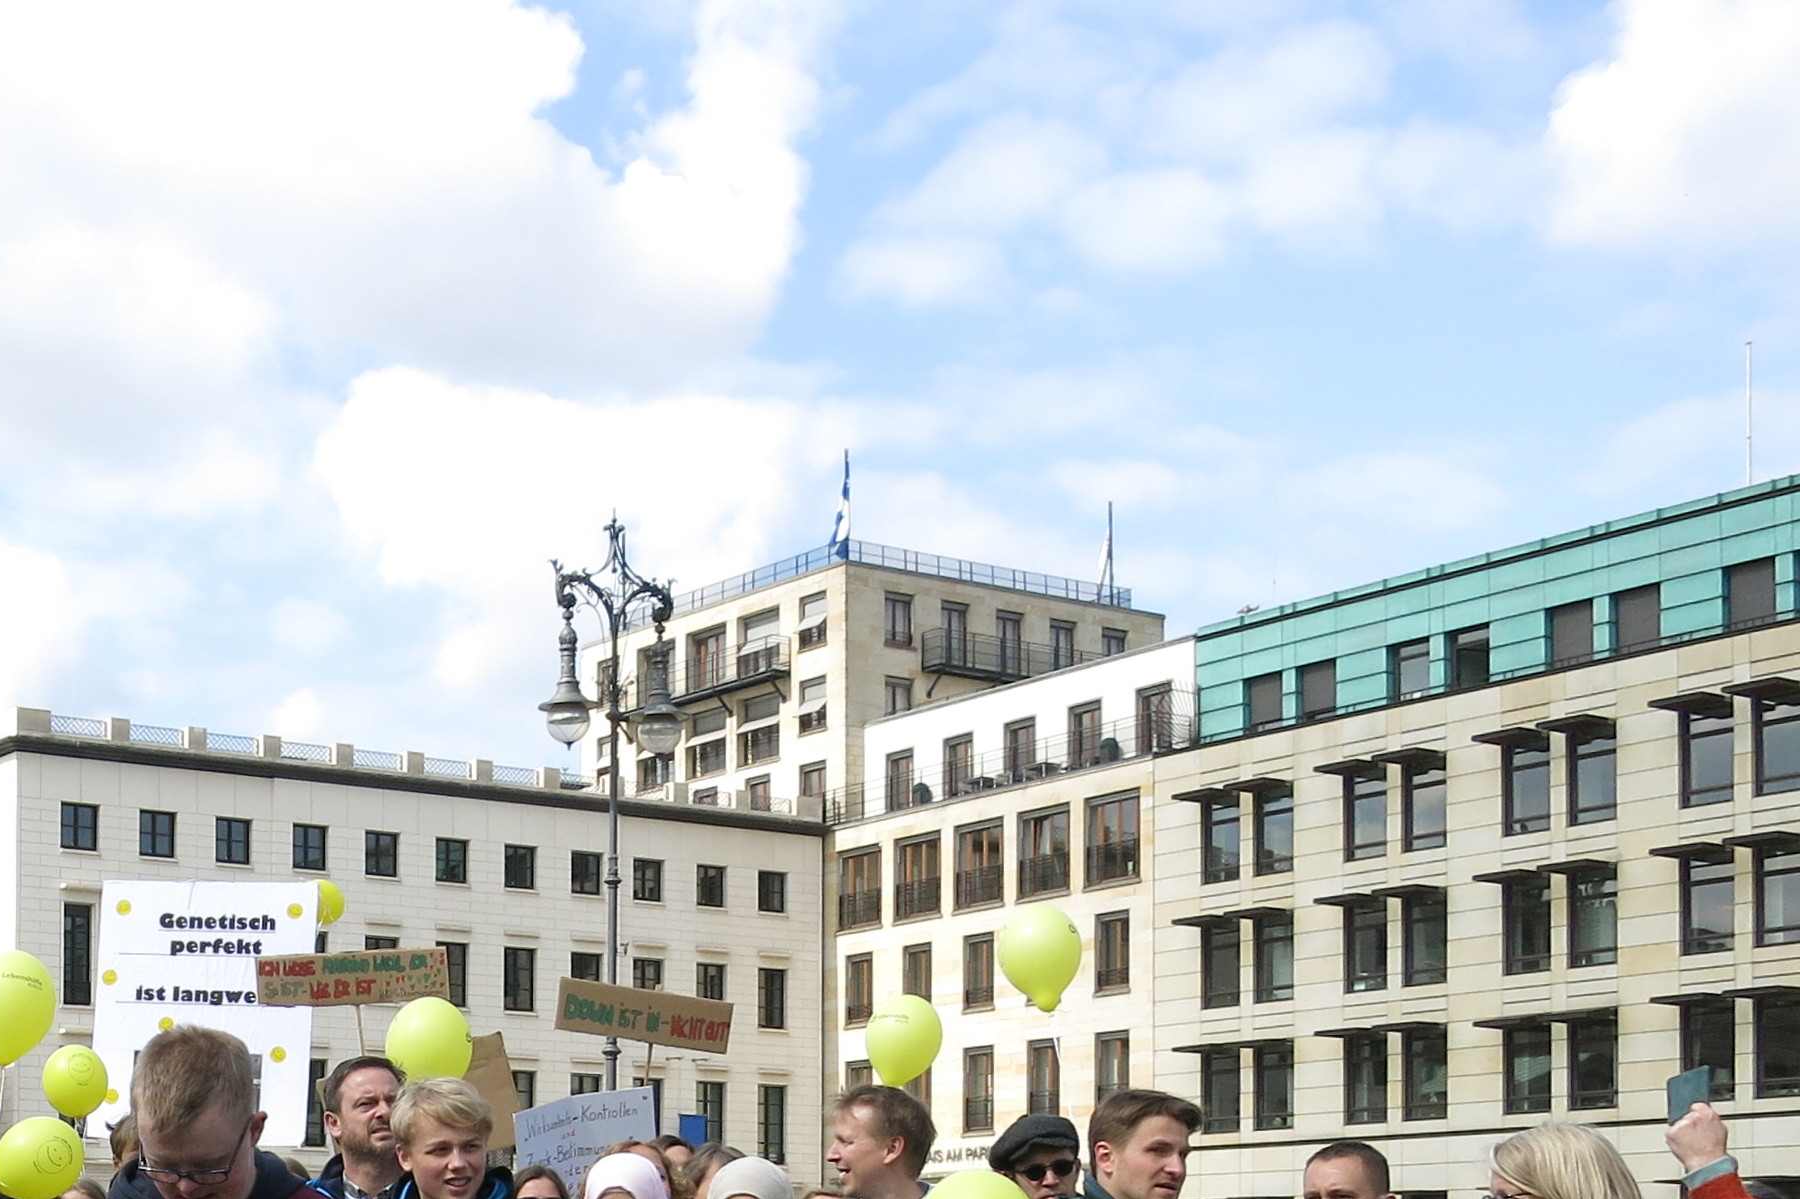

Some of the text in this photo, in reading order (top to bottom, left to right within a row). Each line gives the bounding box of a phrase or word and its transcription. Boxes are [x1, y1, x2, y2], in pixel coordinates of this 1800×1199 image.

[159, 913, 276, 931] Genetisch
[170, 938, 263, 956] perfekt
[136, 985, 257, 1006] ist langwe
